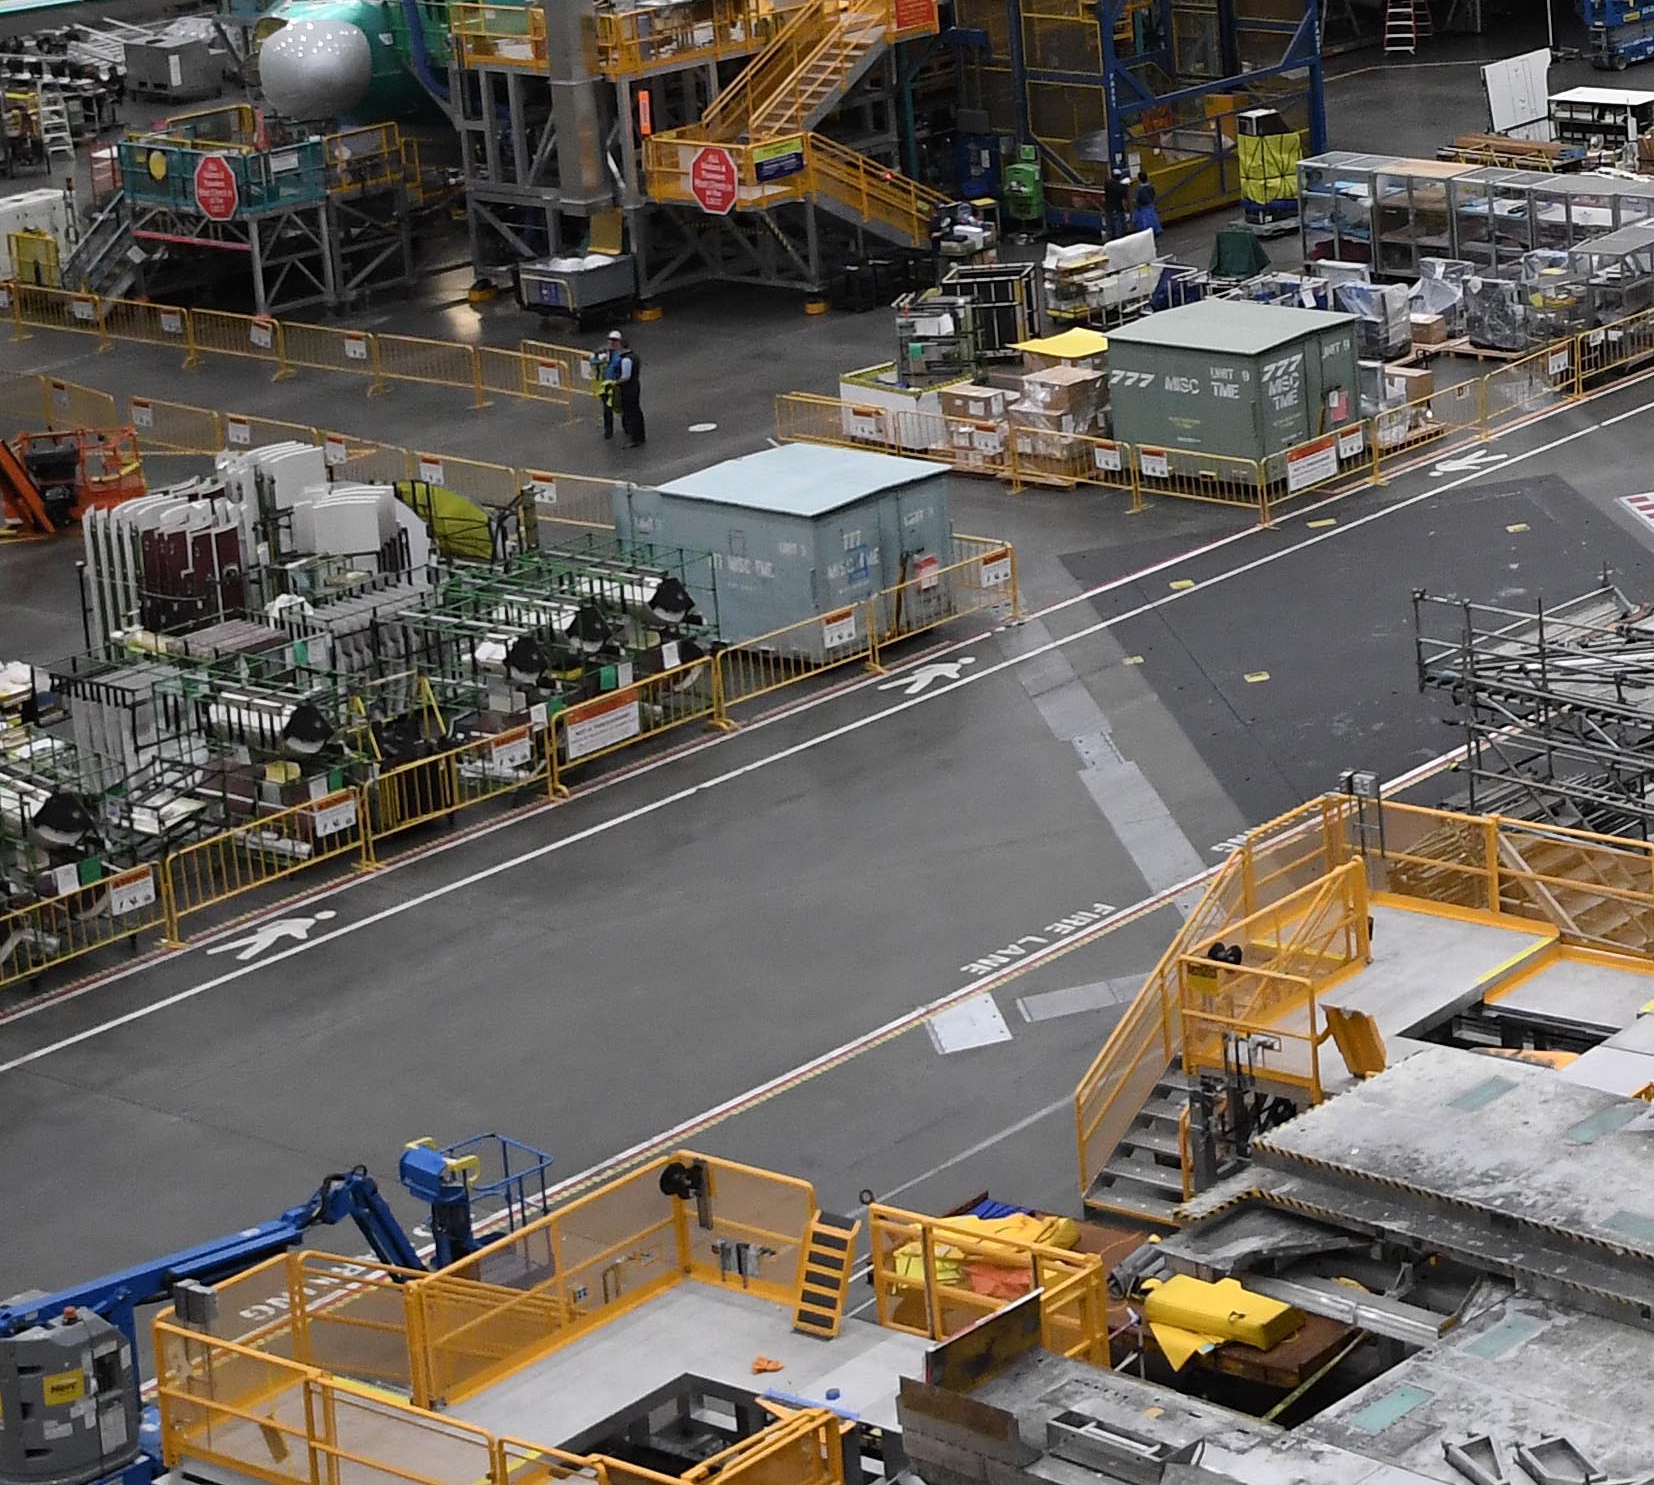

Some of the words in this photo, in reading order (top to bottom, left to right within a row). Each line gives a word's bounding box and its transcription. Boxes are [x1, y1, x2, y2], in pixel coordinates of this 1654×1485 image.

[1262, 353, 1304, 383] 777
[1107, 369, 1155, 388] 777
[1164, 375, 1201, 395] MISC
[1210, 381, 1240, 400] TME
[1272, 389, 1299, 411] TME
[1043, 902, 1117, 936] FIRE
[960, 935, 1049, 976] LANE
